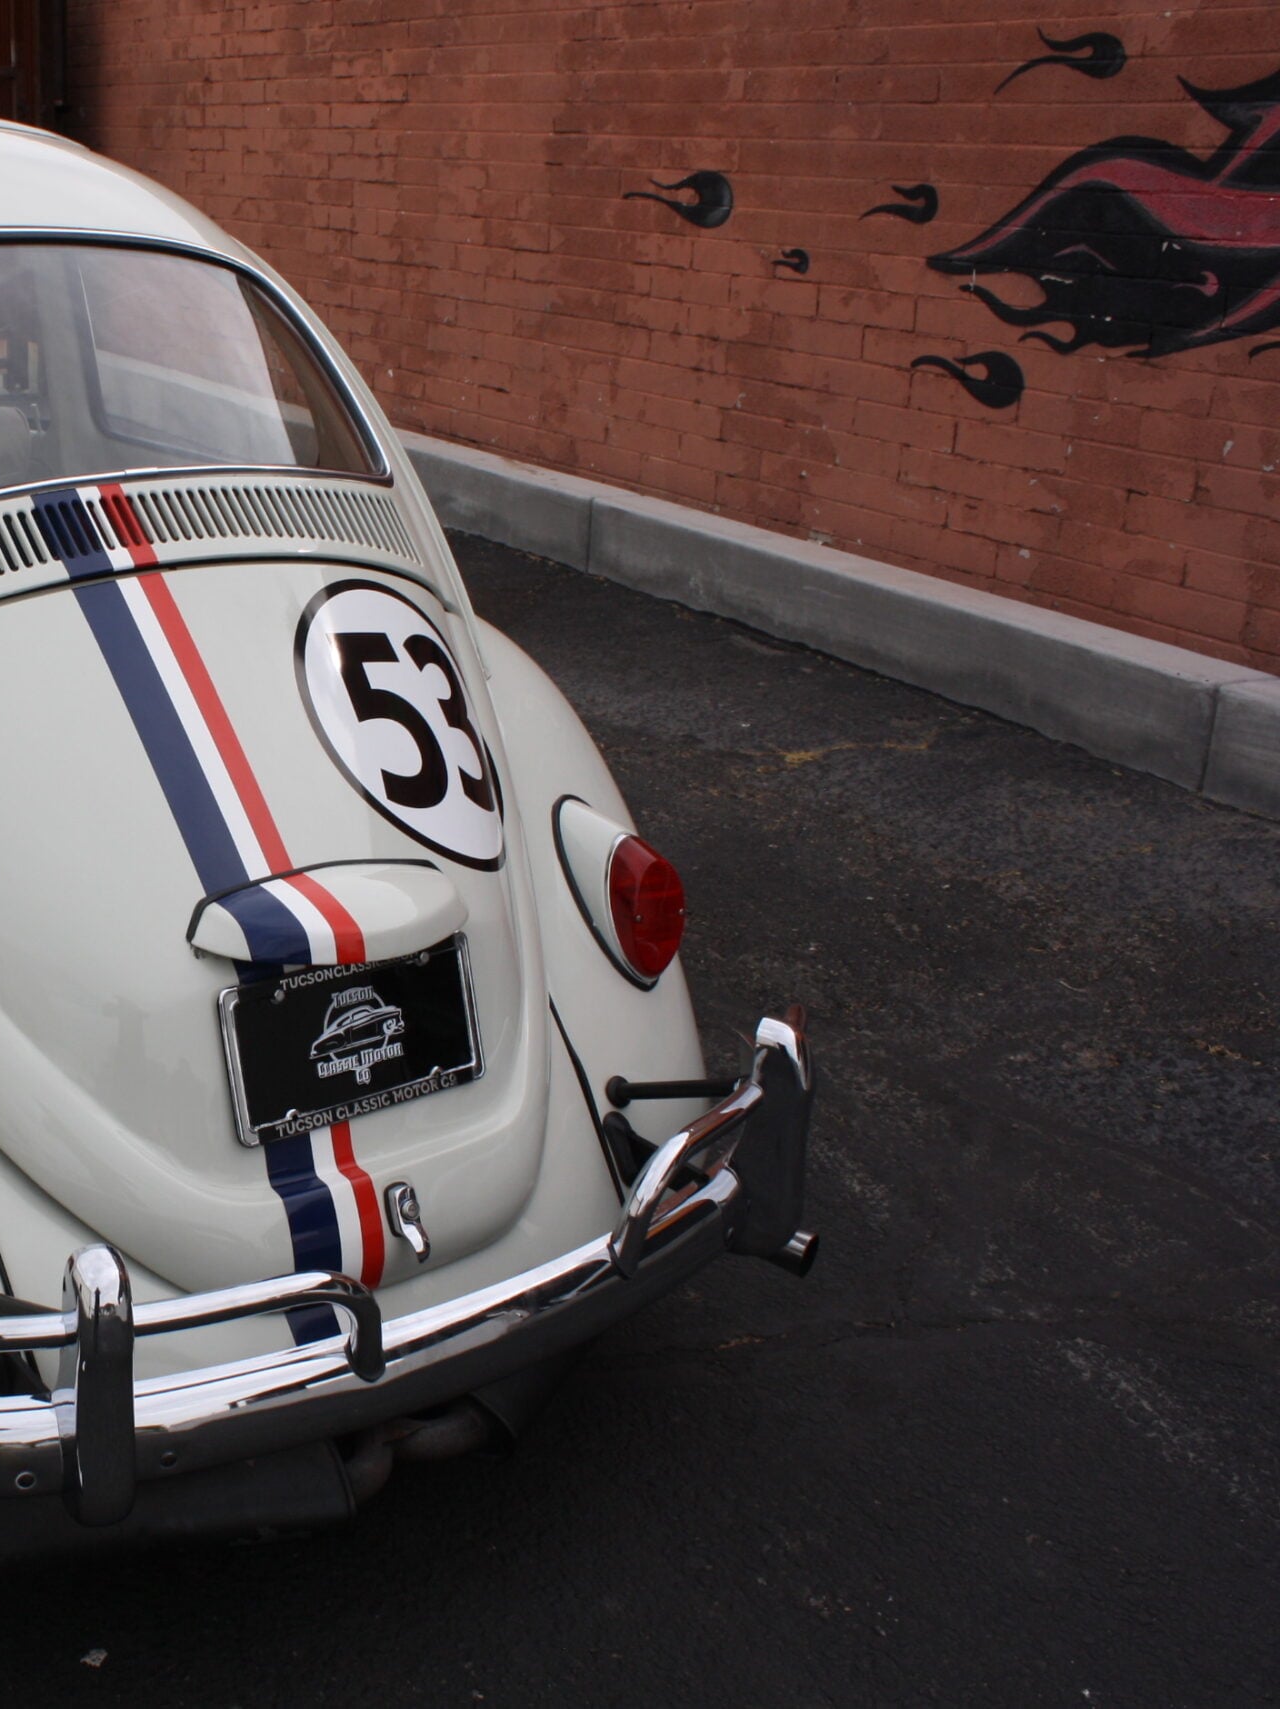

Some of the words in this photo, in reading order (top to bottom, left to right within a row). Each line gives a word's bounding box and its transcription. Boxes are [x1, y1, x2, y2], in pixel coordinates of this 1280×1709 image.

[325, 631, 496, 813] 53
[275, 1111, 334, 1138] TUCSON
[335, 1093, 391, 1121] CLASSIC
[392, 1077, 438, 1104] MOTOR
